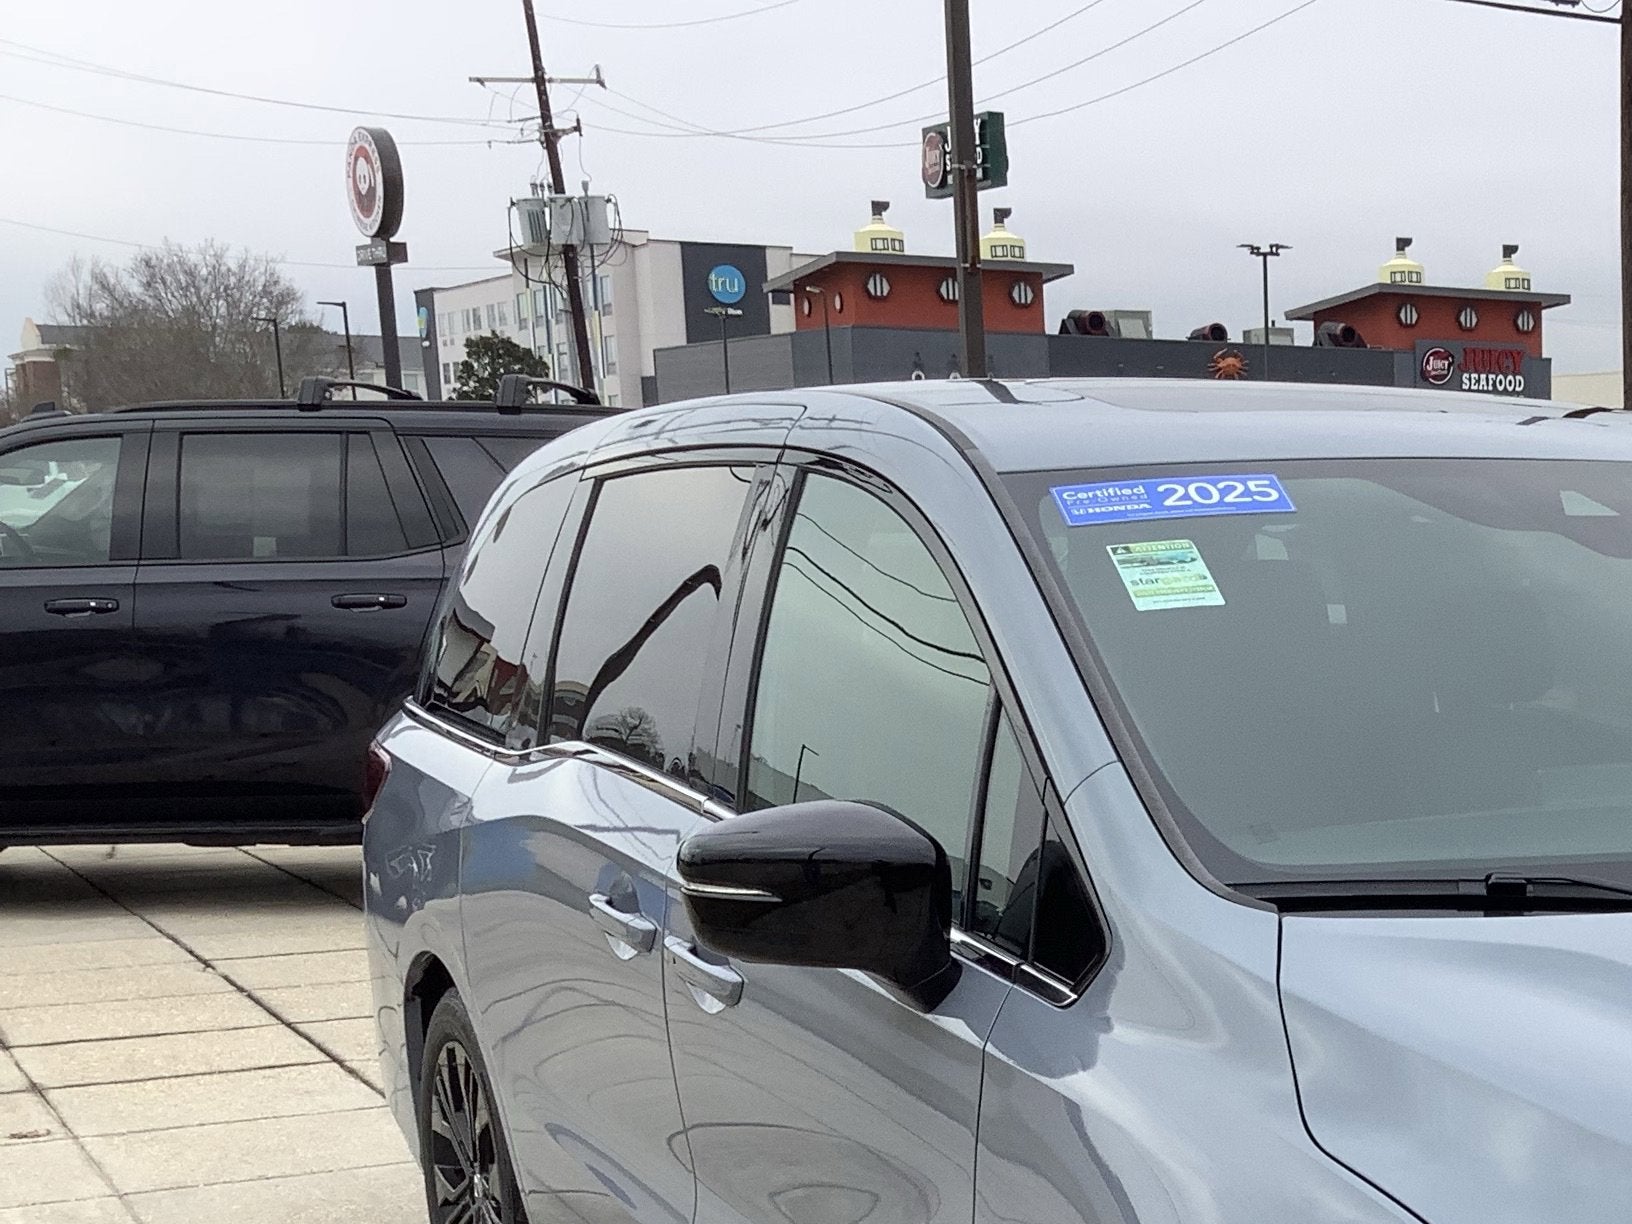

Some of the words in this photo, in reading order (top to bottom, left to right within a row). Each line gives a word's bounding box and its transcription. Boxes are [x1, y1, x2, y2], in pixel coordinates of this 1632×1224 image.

[709, 272, 739, 293] tru
[1458, 347, 1525, 373] JUICY
[1462, 373, 1525, 392] SEAFOOD
[1062, 484, 1146, 501] Certified
[1156, 479, 1280, 507] 2025
[1086, 502, 1153, 514] HONDA
[1135, 542, 1191, 552] ATTENTION
